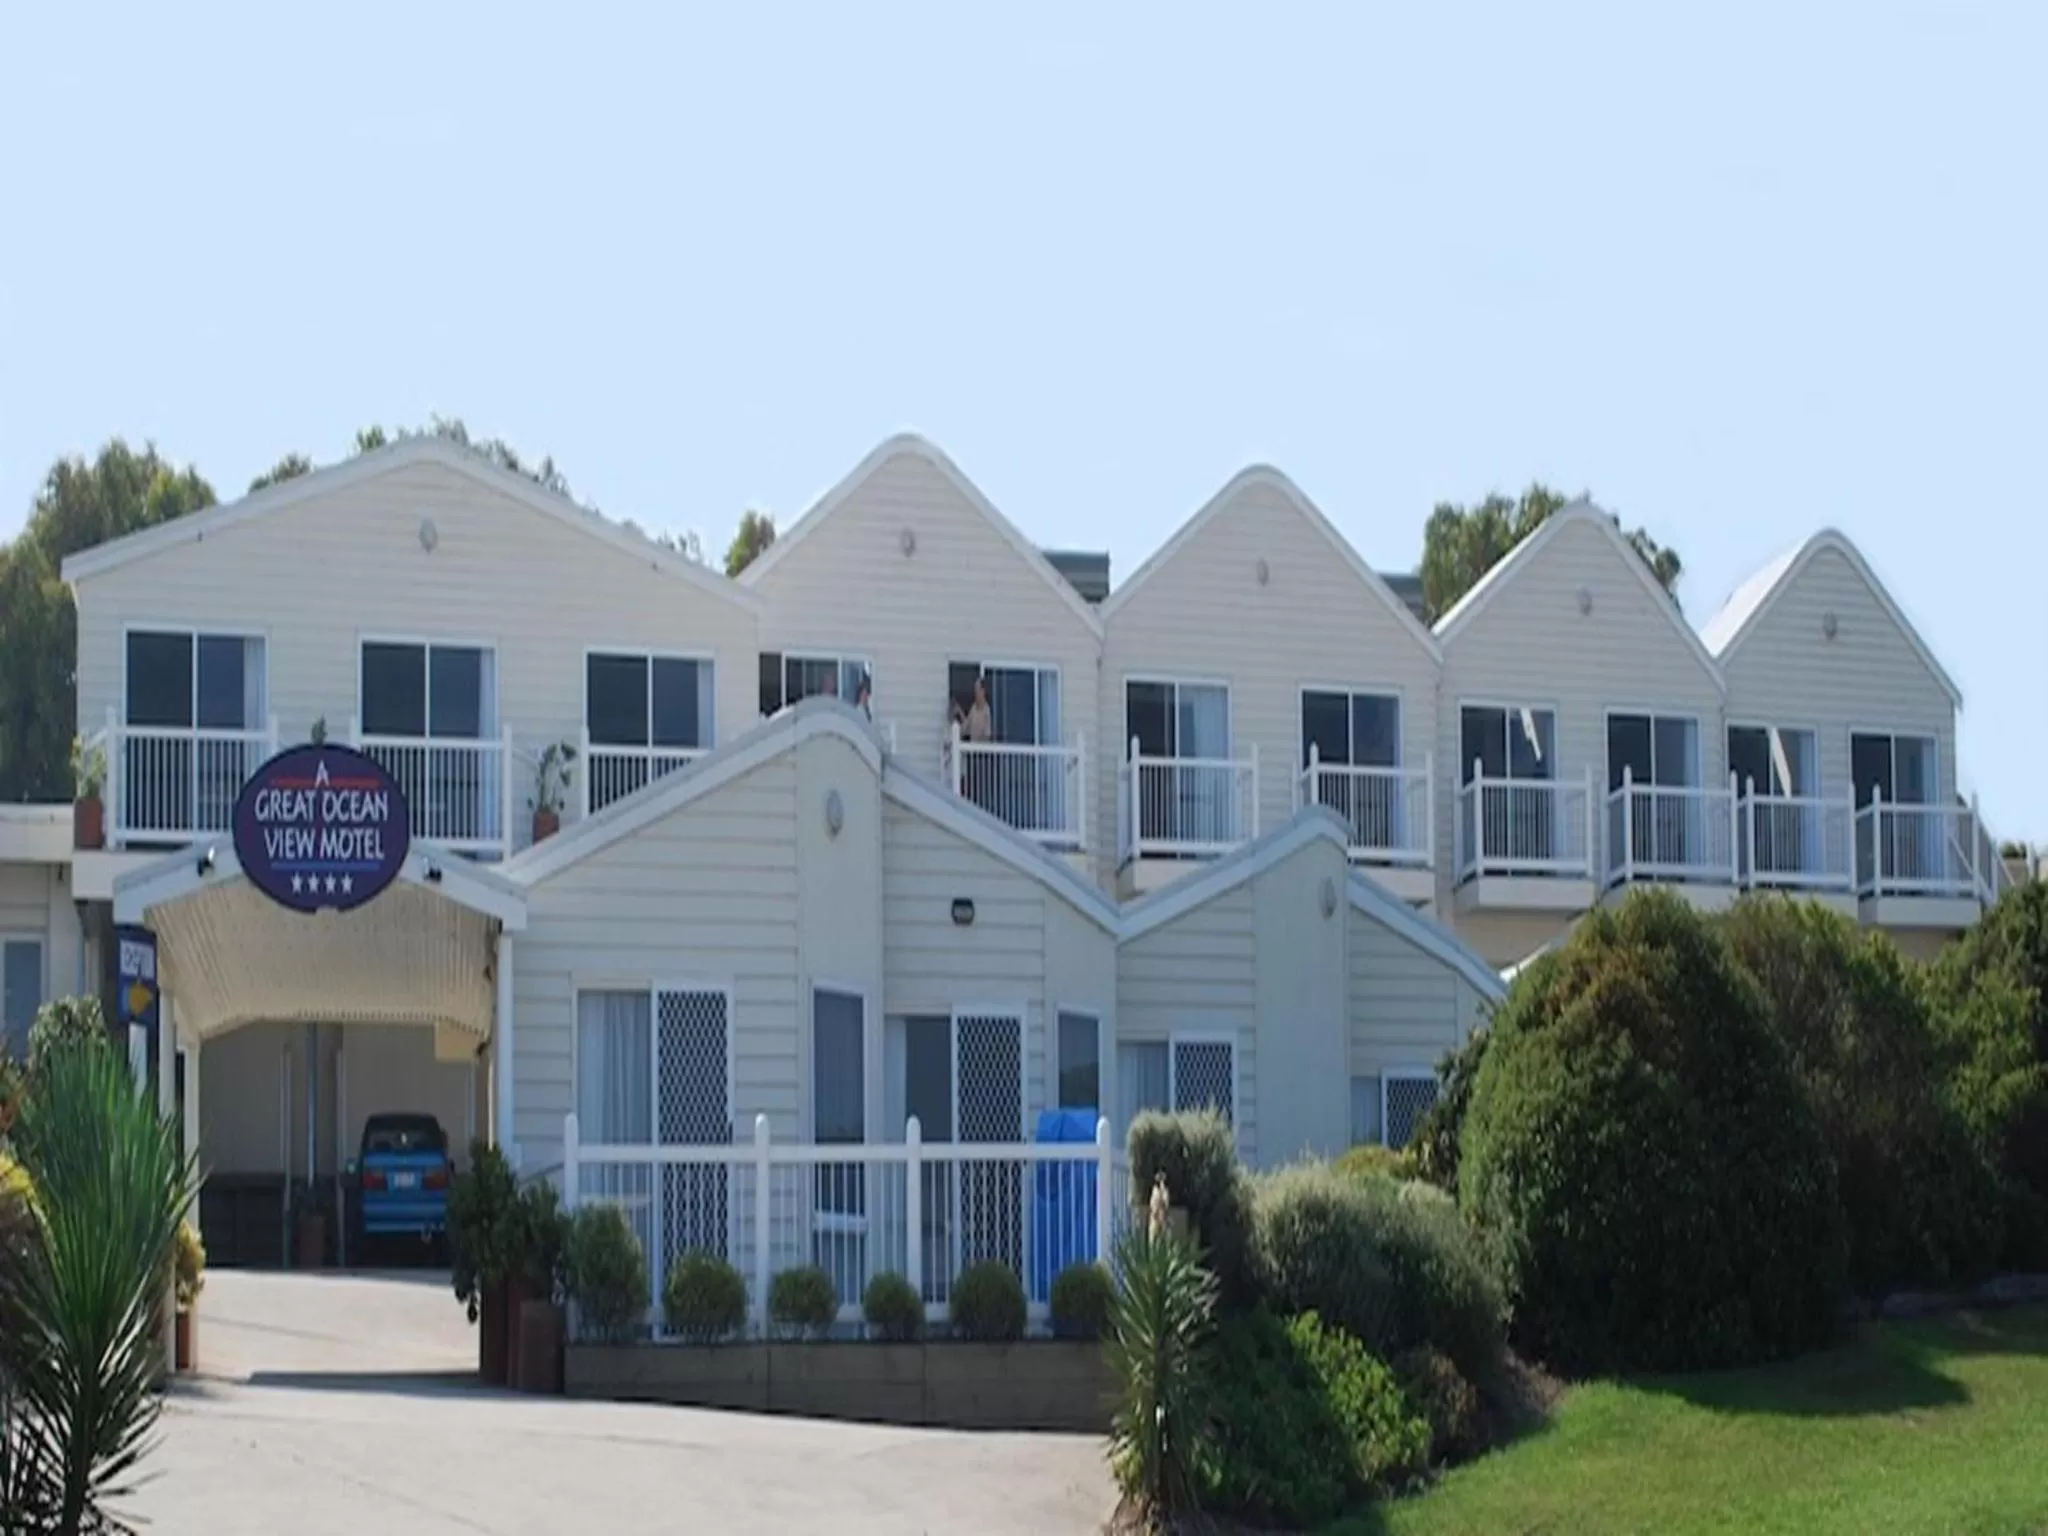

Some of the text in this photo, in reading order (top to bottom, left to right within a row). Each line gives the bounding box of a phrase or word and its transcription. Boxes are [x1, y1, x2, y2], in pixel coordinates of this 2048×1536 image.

[315, 759, 330, 788] A
[254, 788, 388, 822] GREAT OCEAN
[264, 827, 385, 860] VIEW MOTEL
